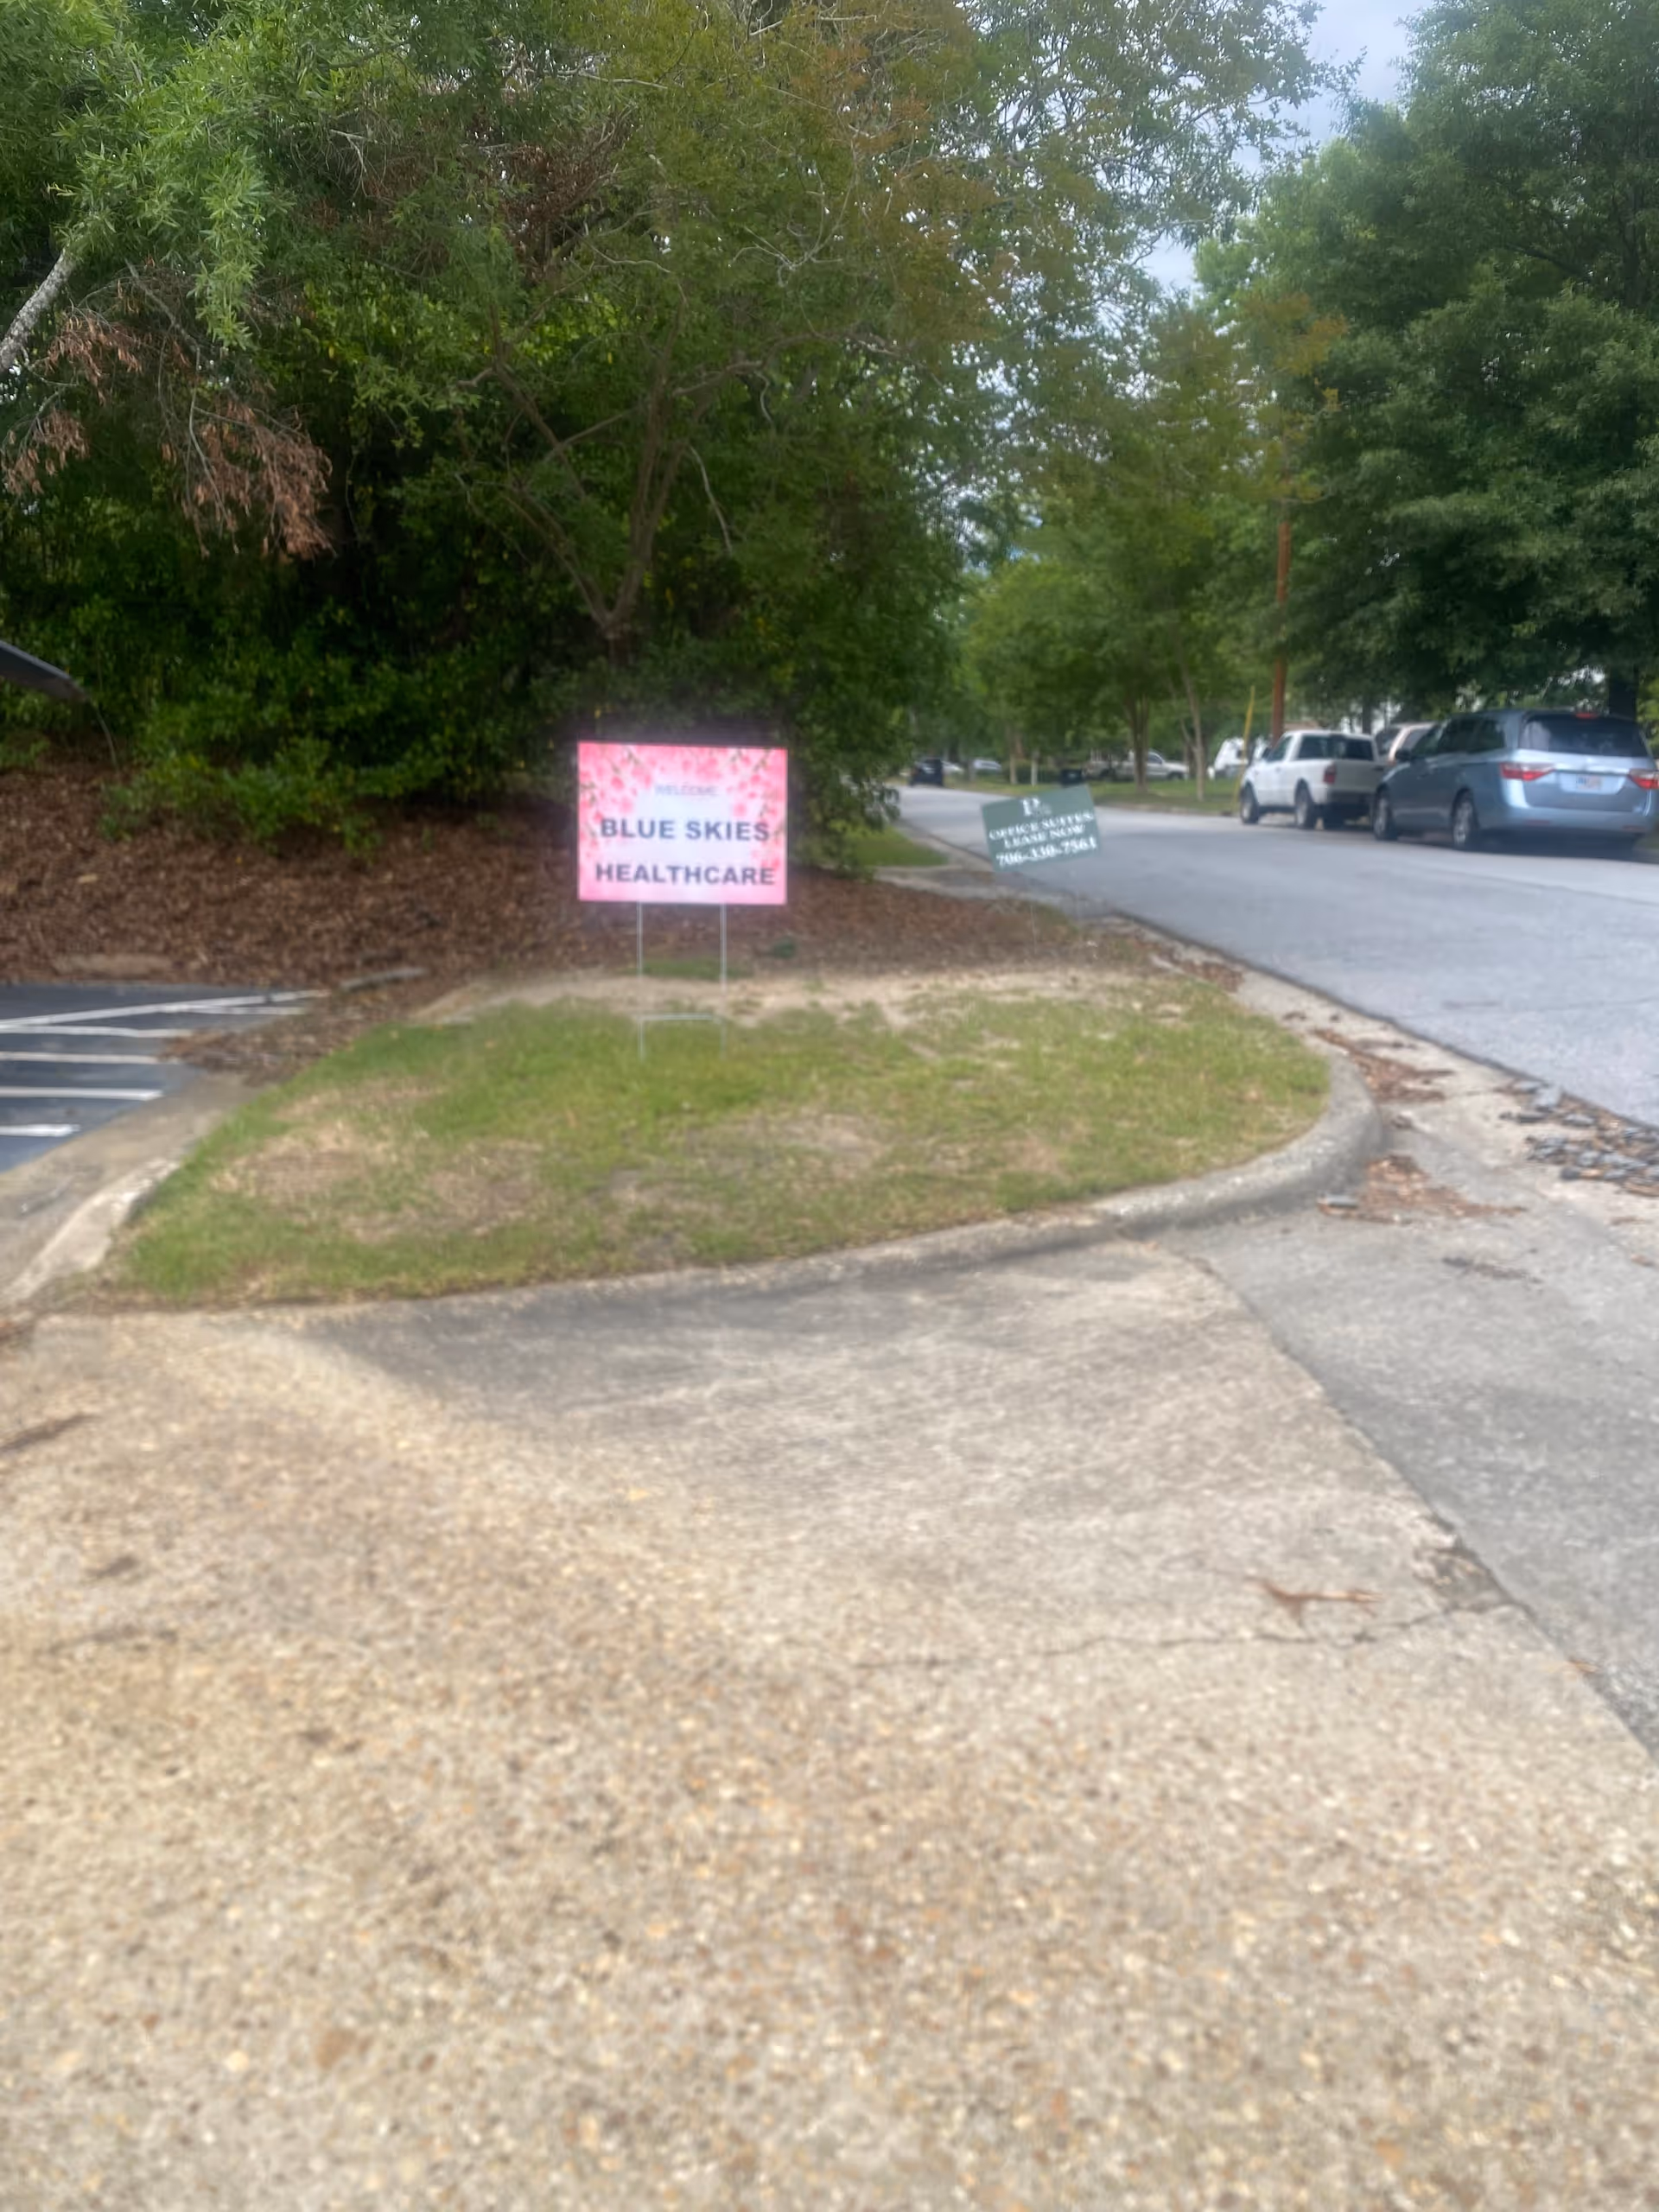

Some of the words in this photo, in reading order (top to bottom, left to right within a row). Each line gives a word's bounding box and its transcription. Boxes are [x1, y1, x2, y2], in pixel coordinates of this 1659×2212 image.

[600, 817, 676, 840] BLUE
[684, 819, 771, 842] SKIES
[1049, 823, 1086, 839] NOW
[595, 863, 776, 886] HEALTHCARE
